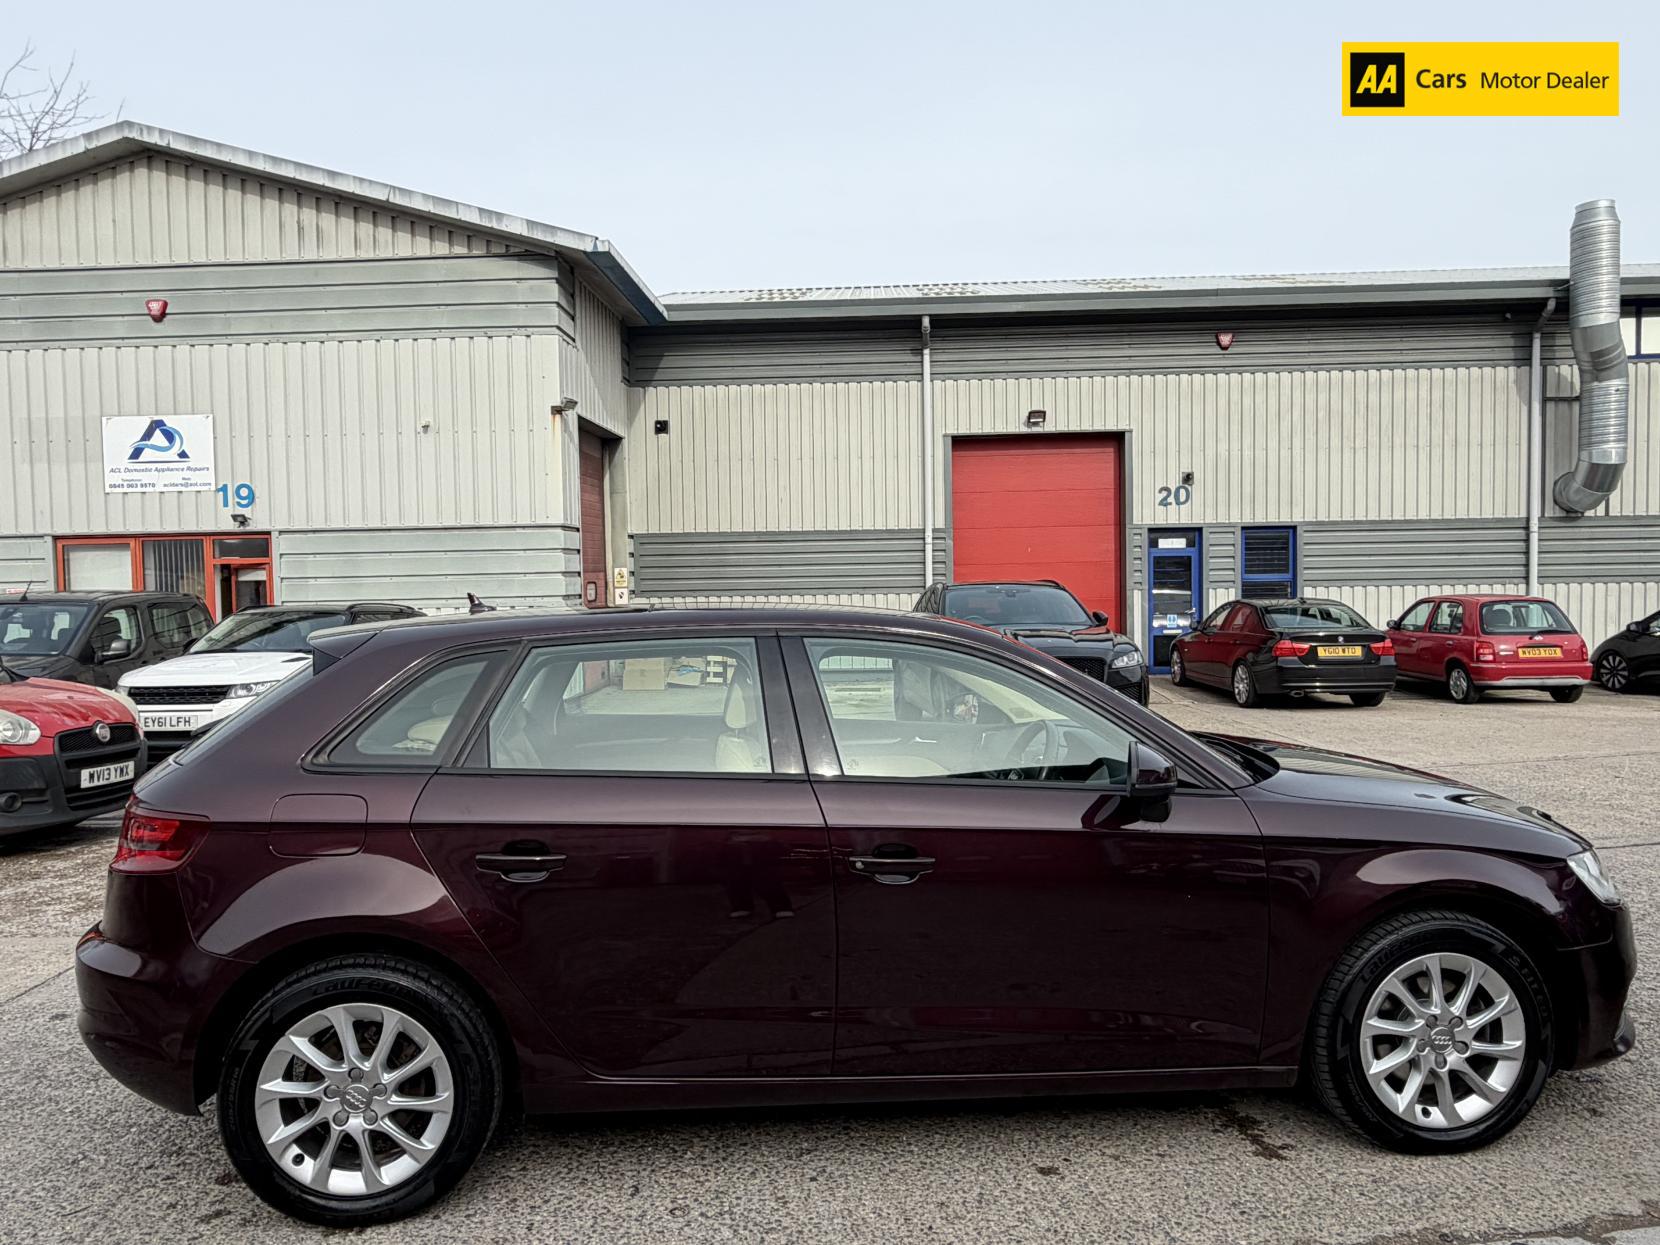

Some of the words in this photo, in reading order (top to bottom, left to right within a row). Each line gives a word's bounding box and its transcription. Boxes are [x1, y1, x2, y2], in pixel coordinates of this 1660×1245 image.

[216, 483, 256, 508] 19
[1158, 485, 1191, 507] 20
[143, 716, 167, 728] EY61
[169, 716, 191, 728] LFH
